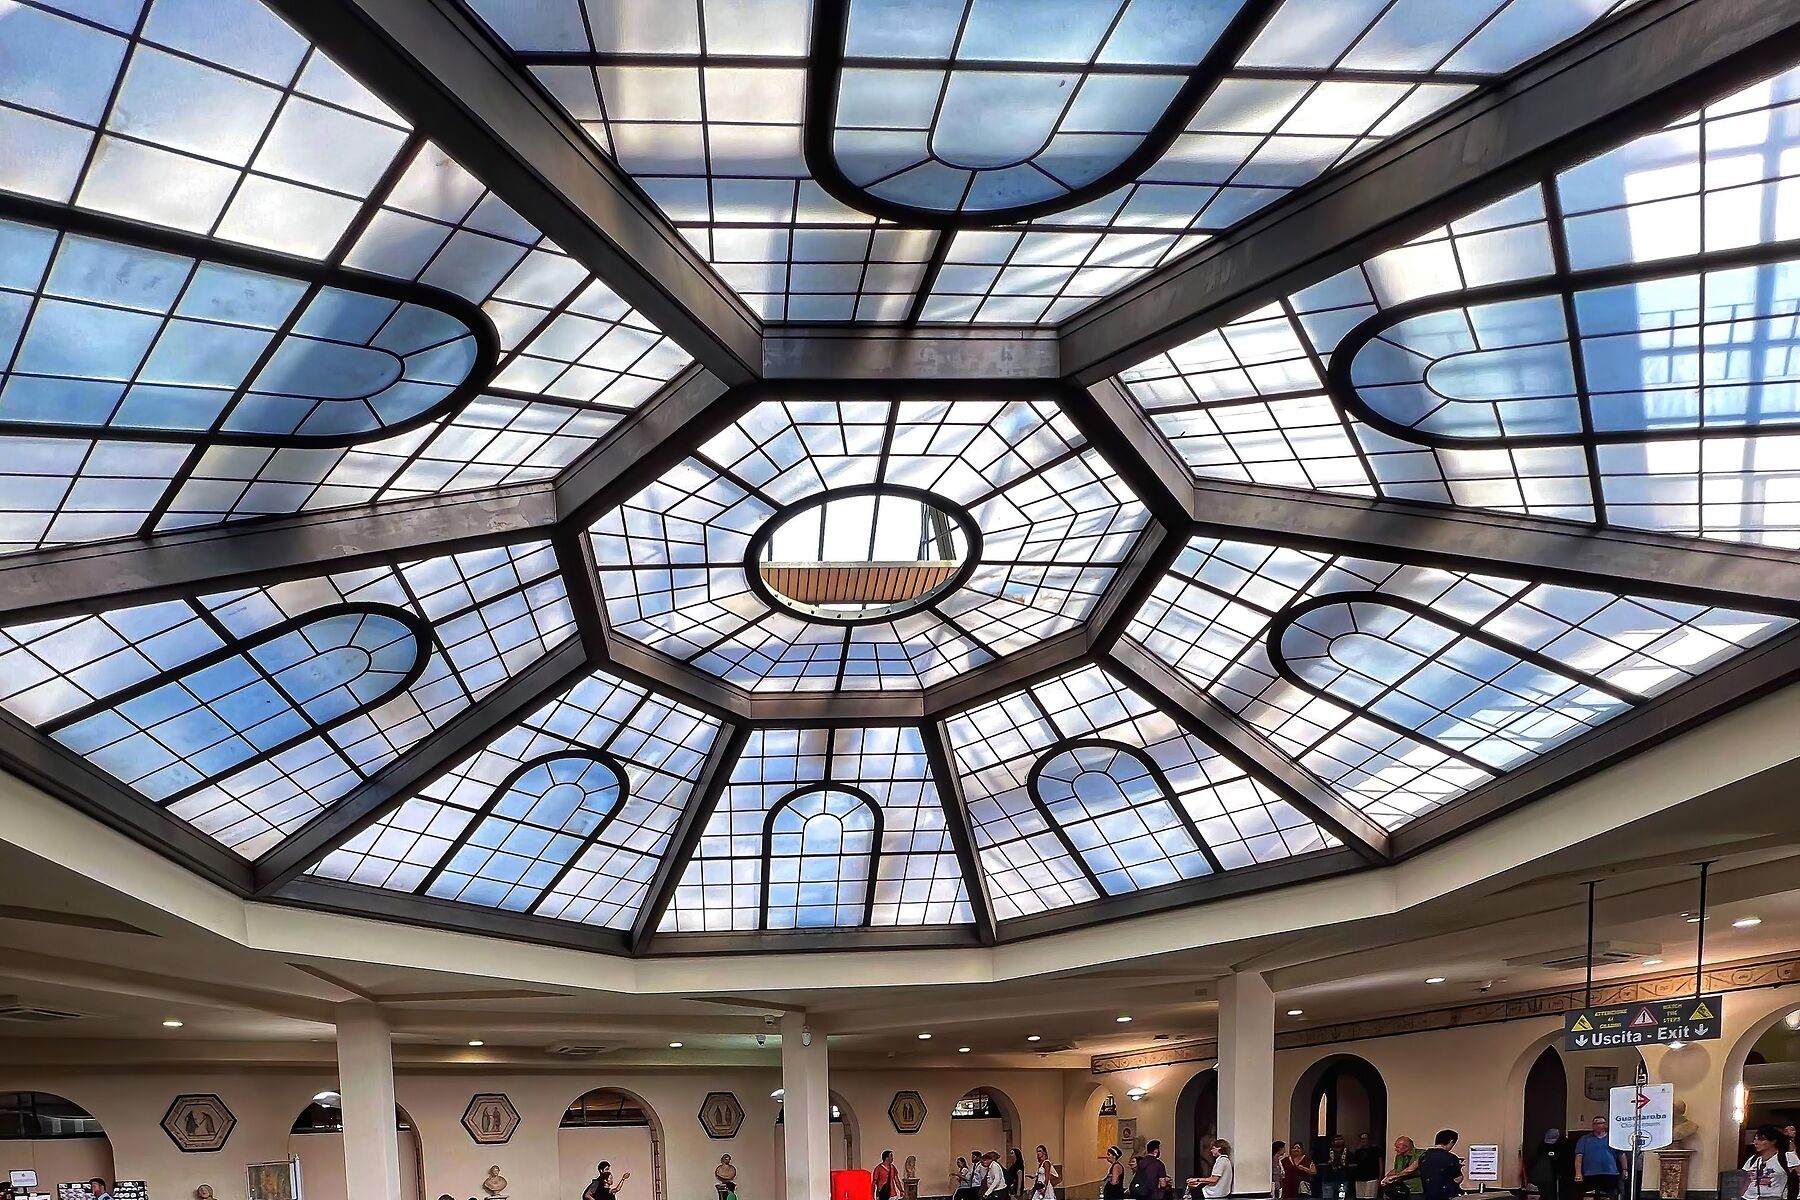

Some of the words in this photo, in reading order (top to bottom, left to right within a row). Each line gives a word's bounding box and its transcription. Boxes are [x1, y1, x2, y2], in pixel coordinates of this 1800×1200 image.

[1591, 1030, 1642, 1046] Uscita
[1657, 1025, 1690, 1040] Exit
[1615, 1113, 1667, 1122] Guararoba
